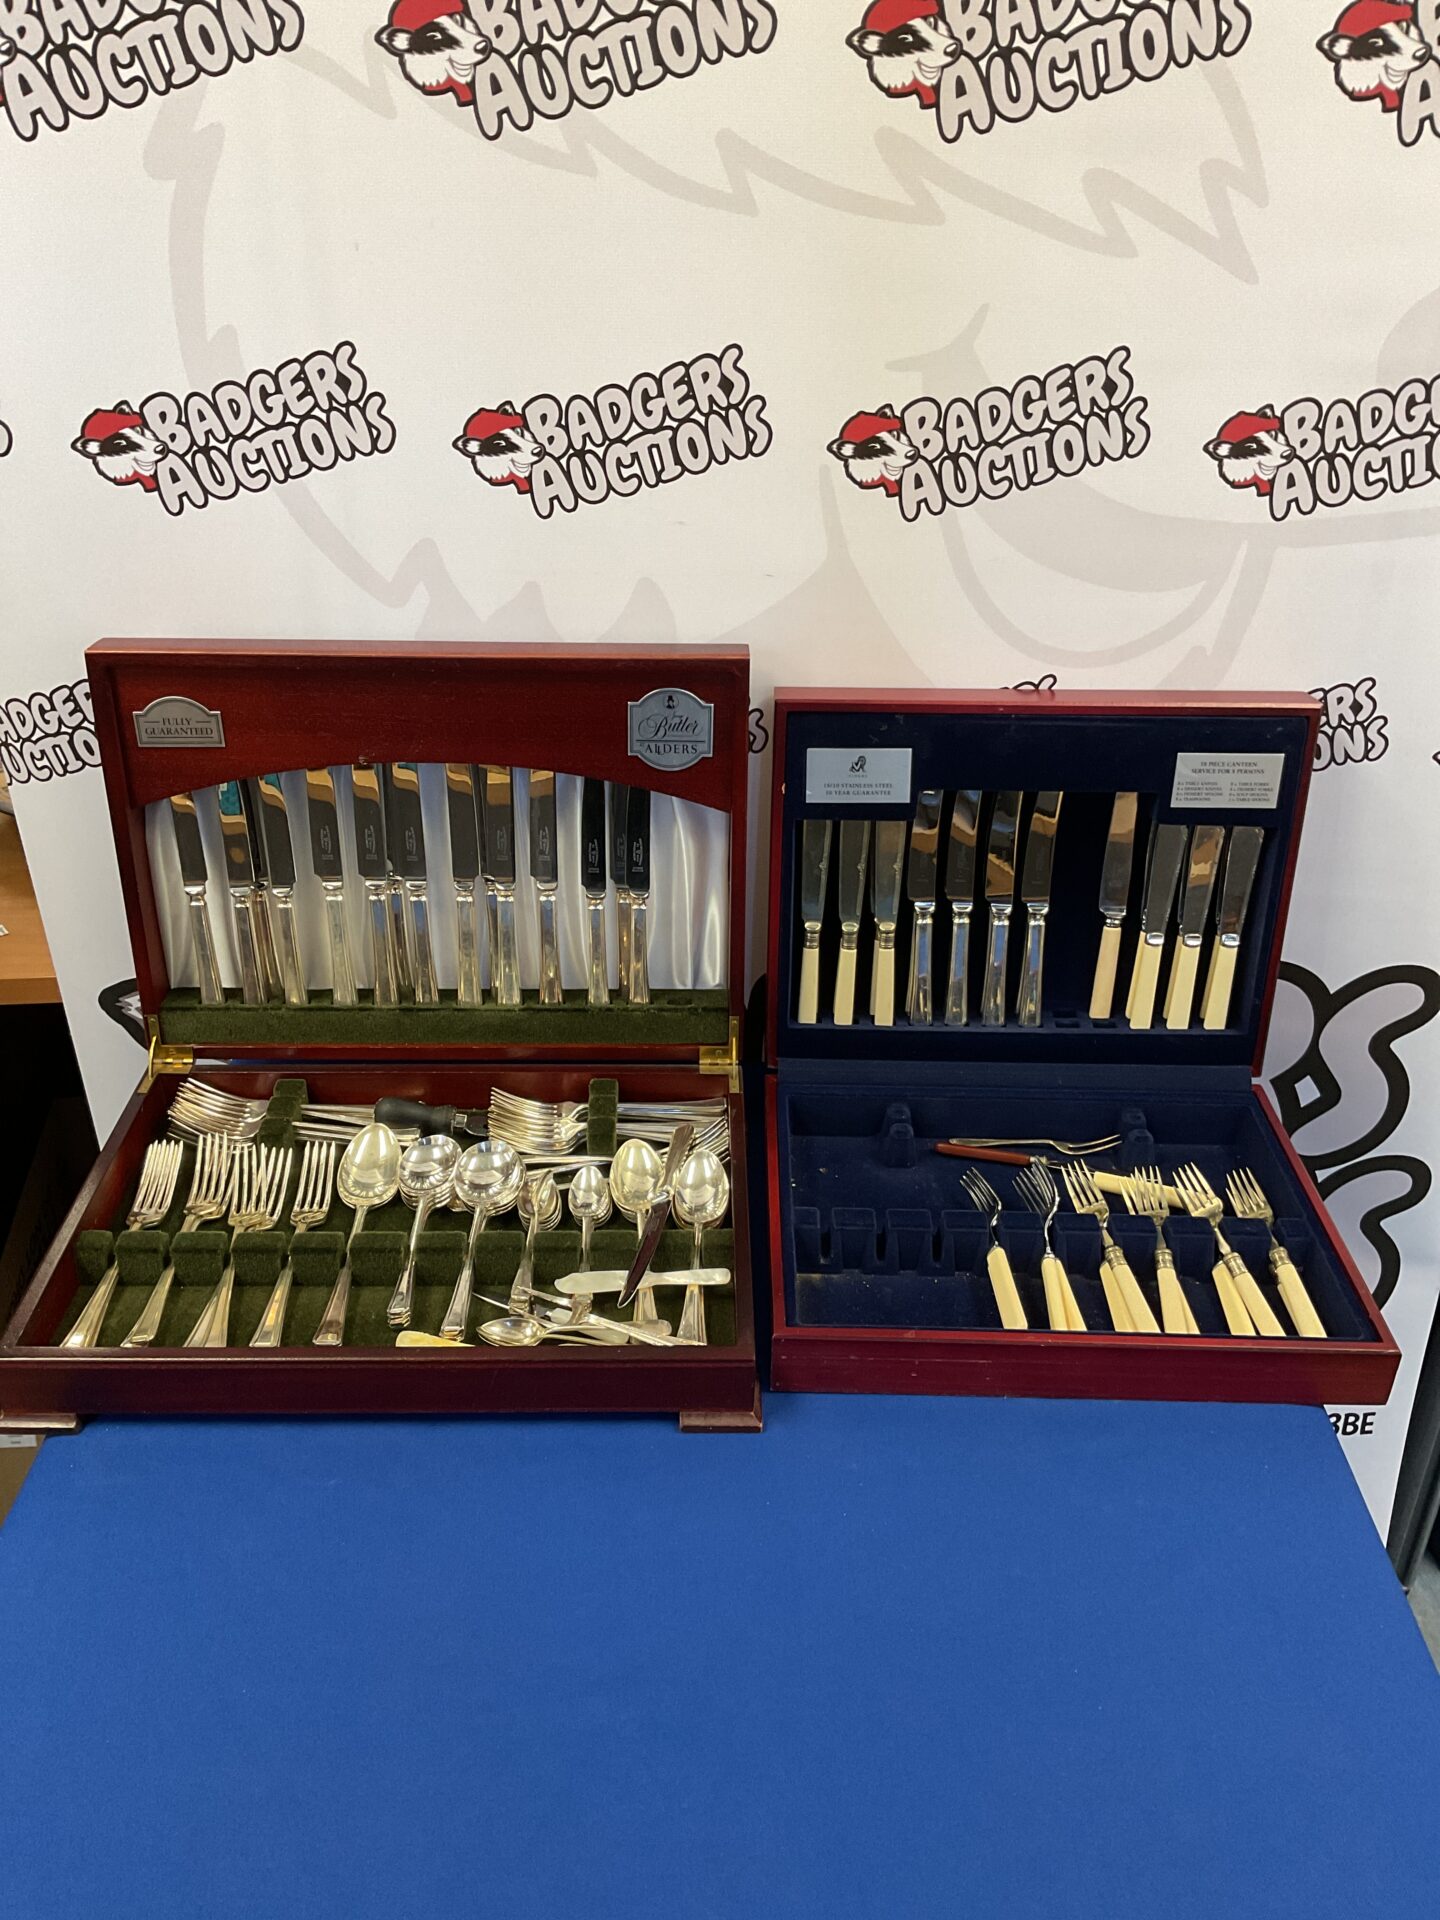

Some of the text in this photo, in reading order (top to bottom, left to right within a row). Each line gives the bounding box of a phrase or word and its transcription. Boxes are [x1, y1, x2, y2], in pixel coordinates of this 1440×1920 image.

[0, 0, 304, 142] AUCTIONS
[473, 0, 778, 141] AUCTIONS
[935, 0, 1252, 144] AUCTIONS
[139, 340, 367, 458] BADGERS
[156, 391, 397, 517] AUCTIONS
[521, 343, 750, 460] BADGERS
[530, 394, 773, 520] AUCTIONS
[900, 345, 1134, 463] BADGERS
[1281, 373, 1440, 463] BADG
[899, 396, 1151, 522] AUCTIONS
[1269, 430, 1440, 522] AUCTI
[0, 726, 102, 786] UCTIO
[145, 727, 213, 736] GUARANTEED
[162, 717, 192, 726] FULLY
[638, 713, 703, 740] Butler
